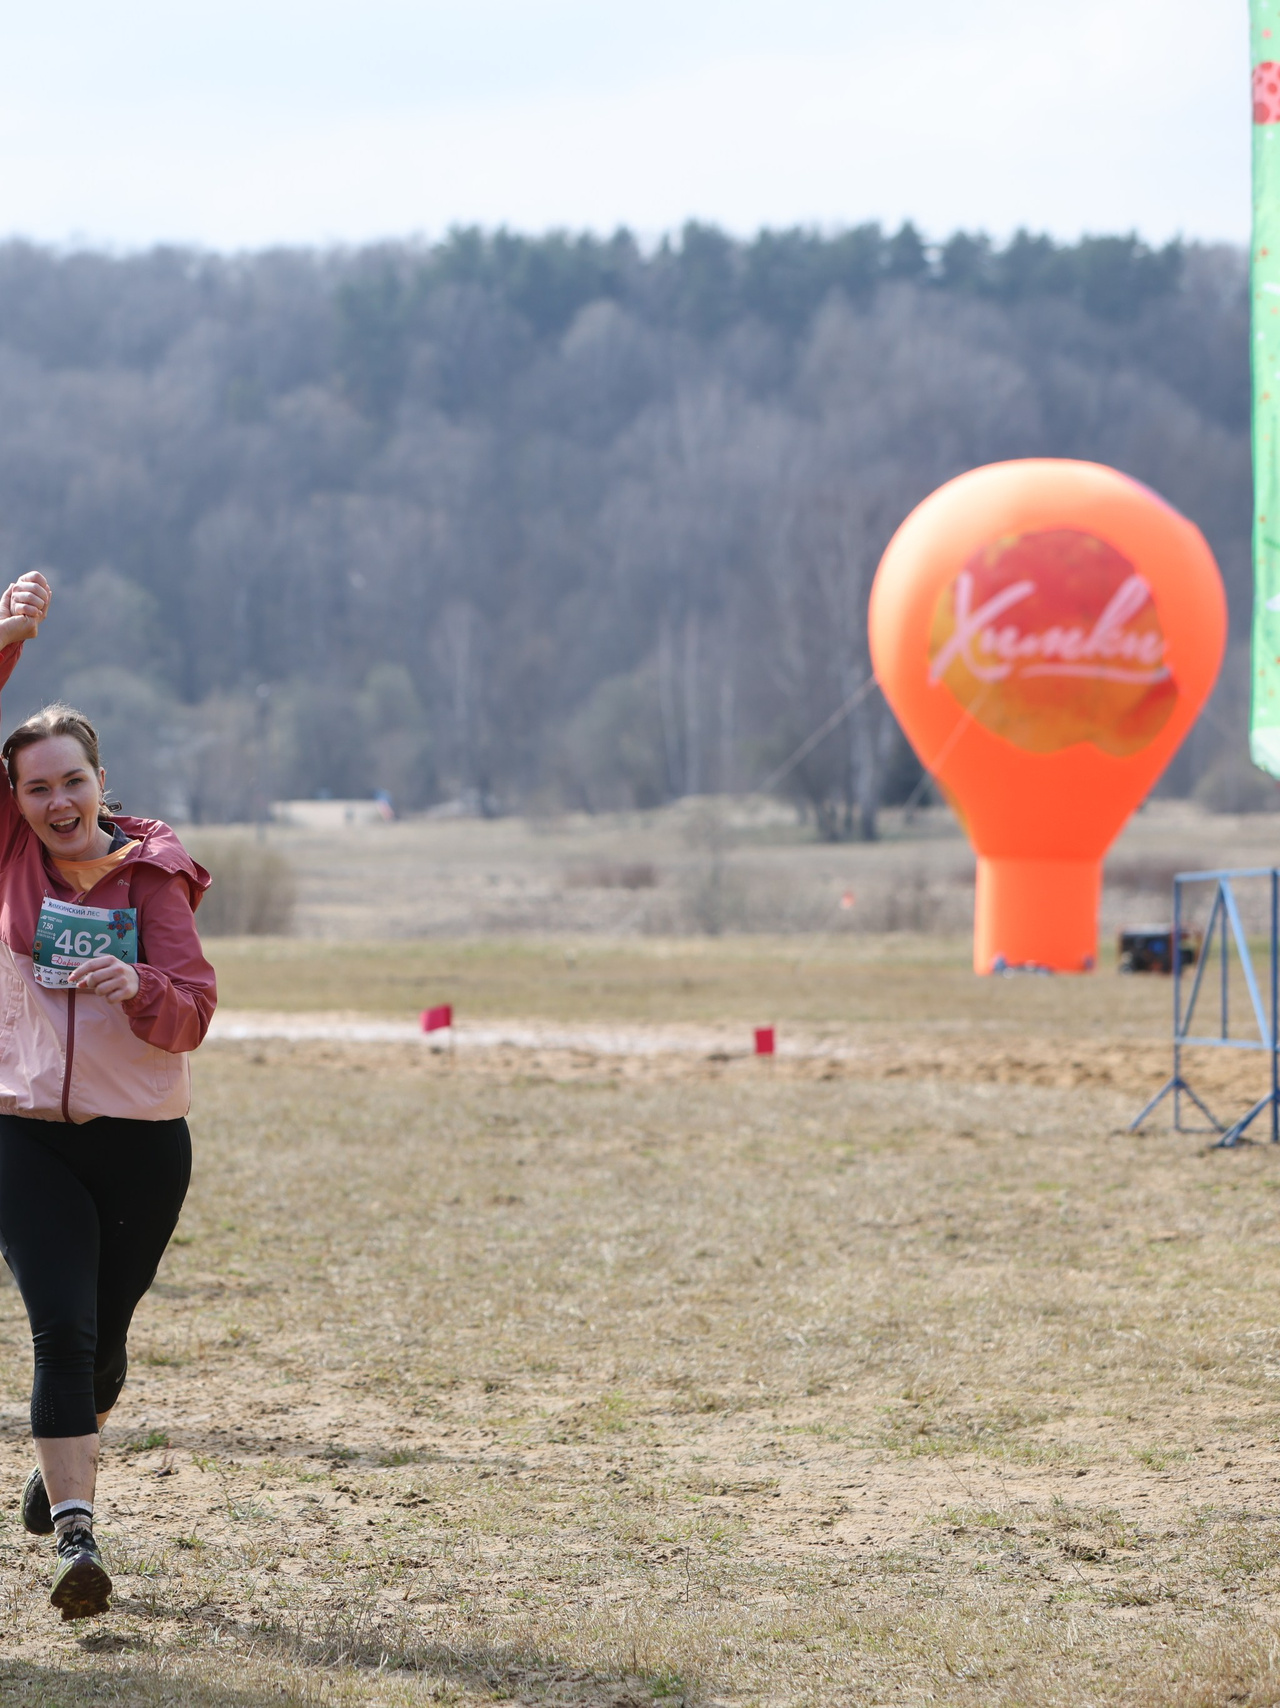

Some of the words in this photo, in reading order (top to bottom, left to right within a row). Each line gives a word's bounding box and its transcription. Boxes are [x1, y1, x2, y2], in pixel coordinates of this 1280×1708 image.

[929, 569, 1169, 685] Химки
[86, 909, 100, 917] ЛЕС
[54, 928, 112, 957] 462
